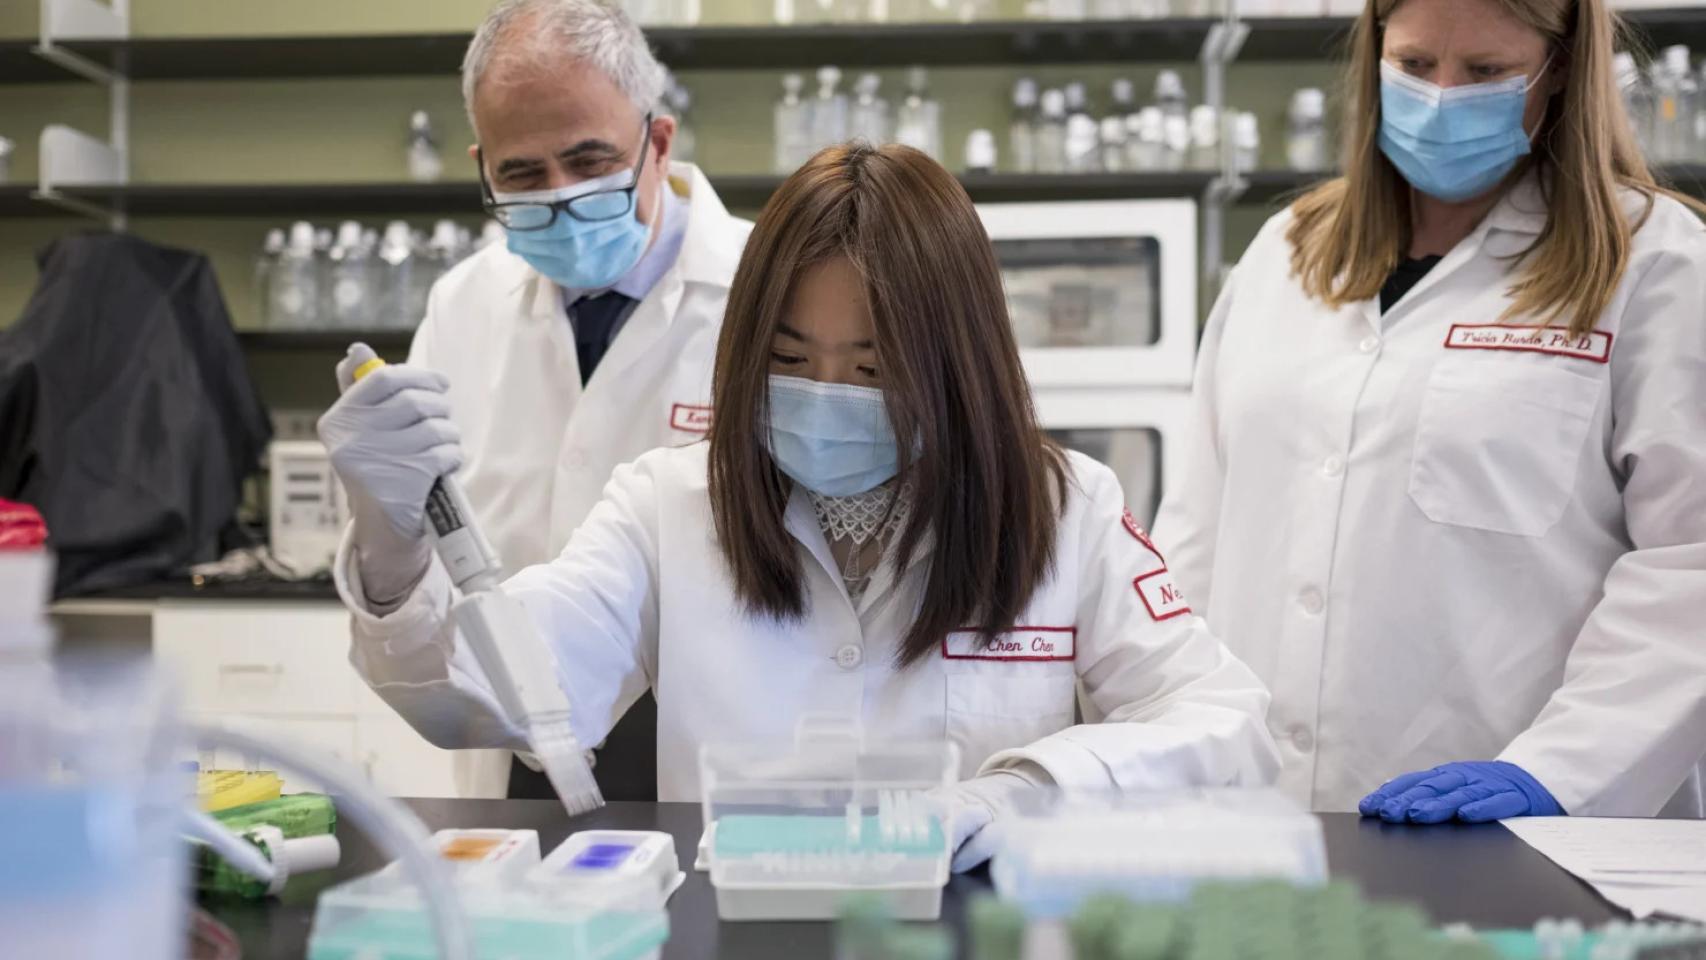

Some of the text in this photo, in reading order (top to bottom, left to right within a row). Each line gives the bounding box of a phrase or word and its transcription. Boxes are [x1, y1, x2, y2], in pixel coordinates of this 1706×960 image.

[1160, 584, 1183, 604] Ne
[987, 637, 1054, 652] Chen Chen
